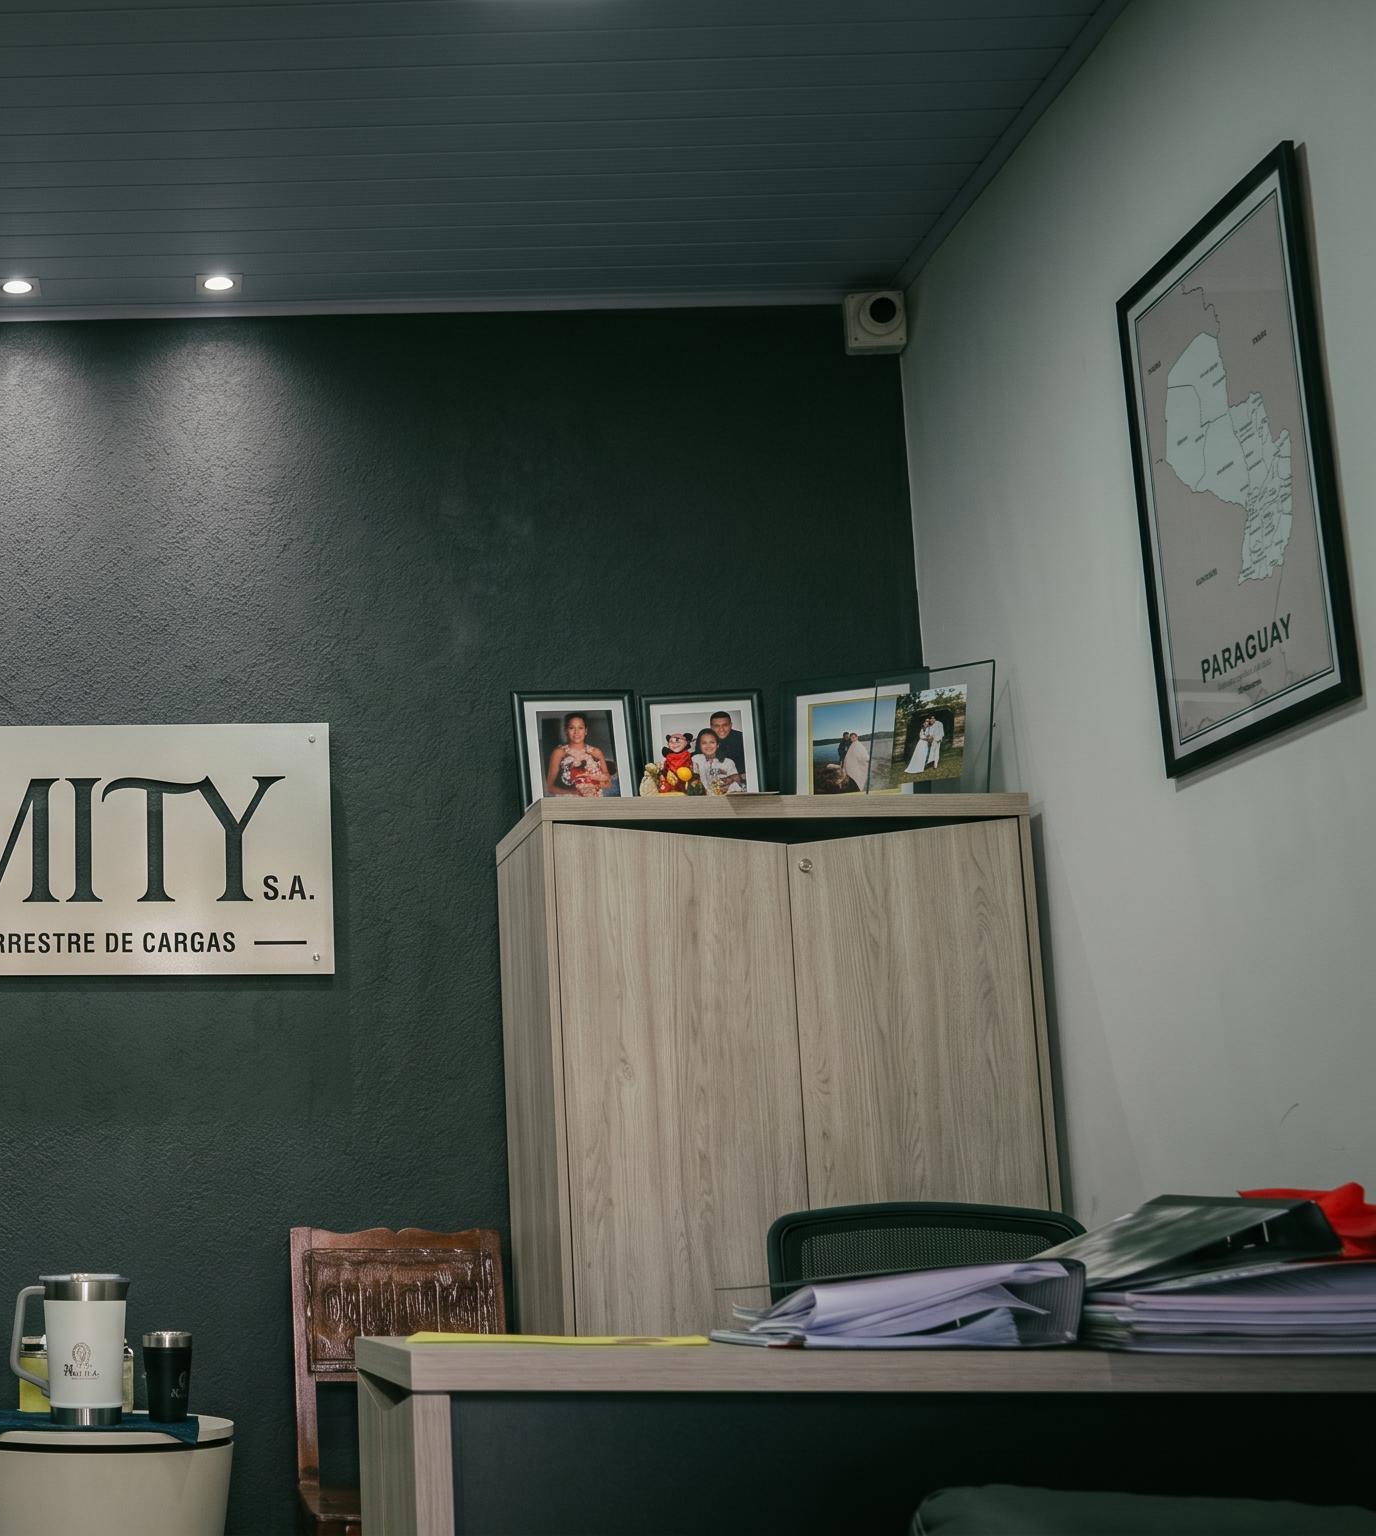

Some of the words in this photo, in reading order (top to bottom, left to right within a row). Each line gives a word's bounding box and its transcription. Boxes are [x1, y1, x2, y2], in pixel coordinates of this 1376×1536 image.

[1201, 613, 1291, 684] PARAGUAY
[263, 875, 315, 901] S.A.
[105, 932, 133, 953] DE
[143, 931, 236, 953] CARGAS
